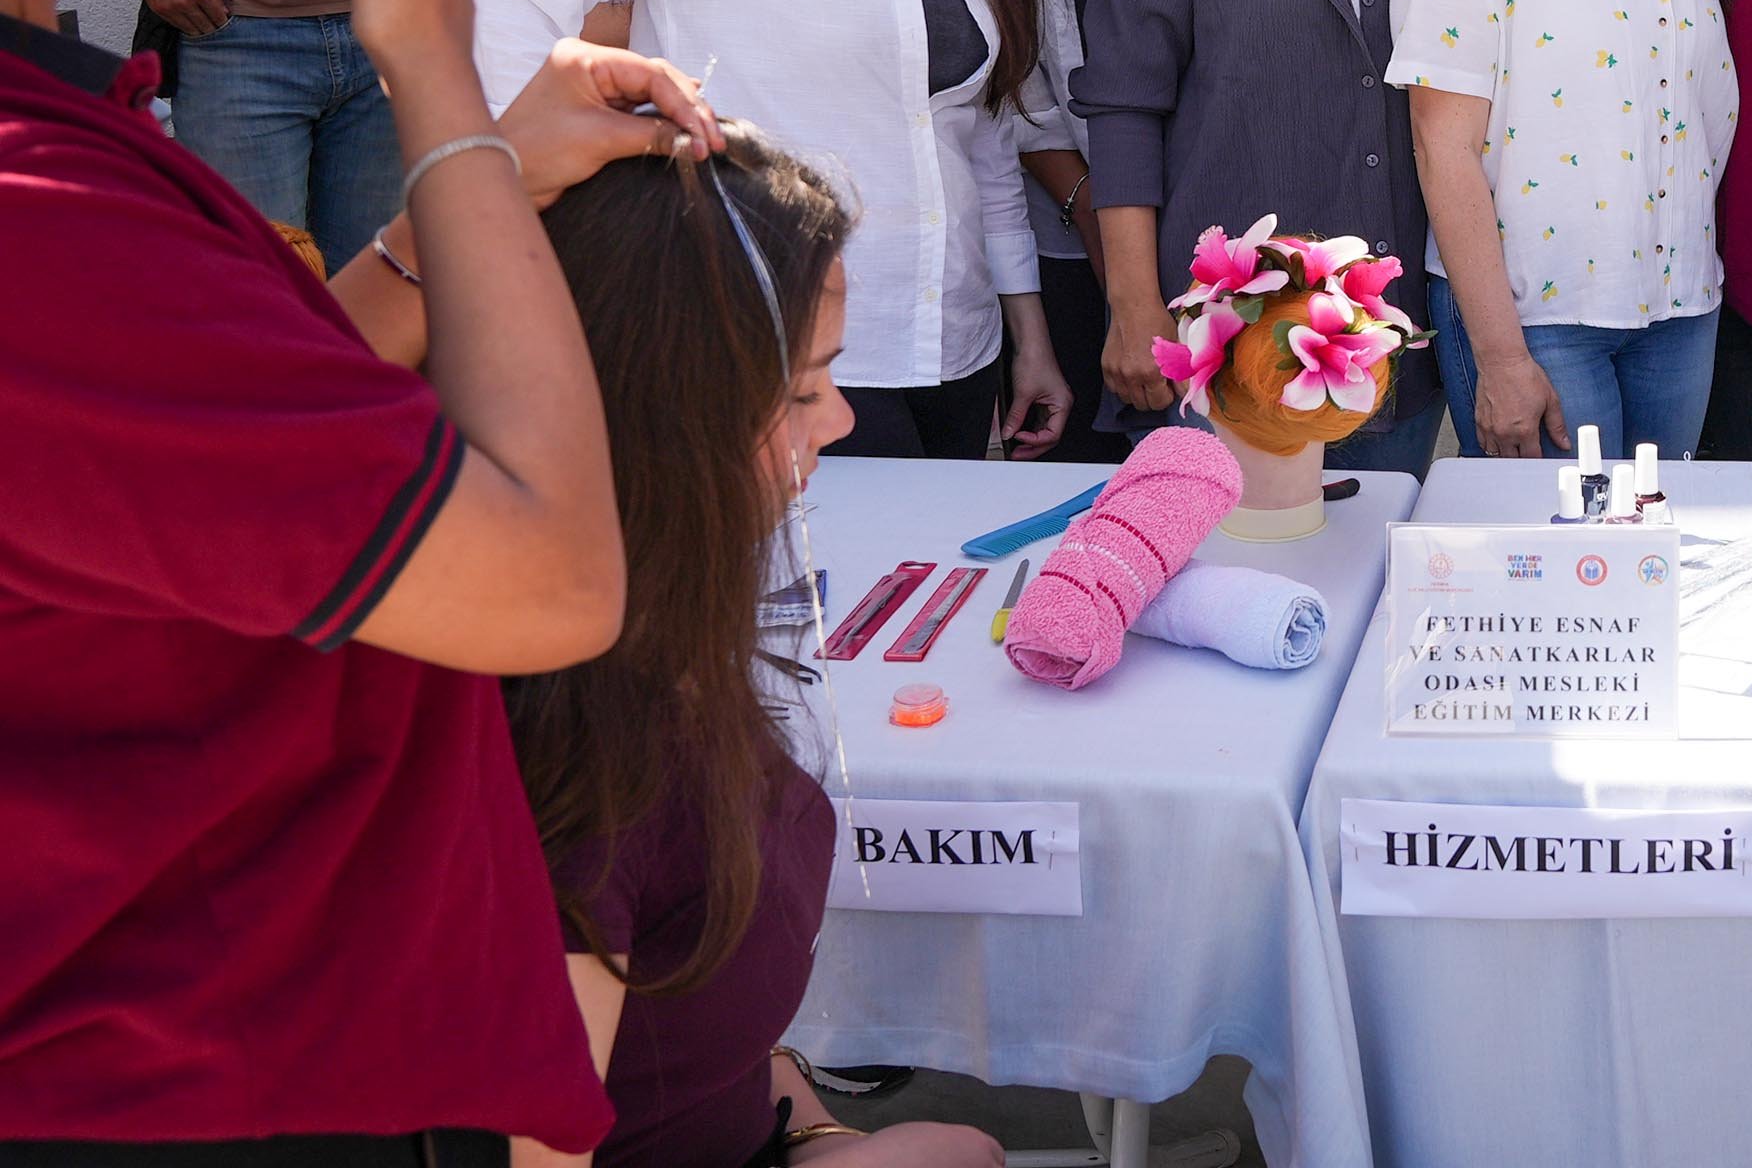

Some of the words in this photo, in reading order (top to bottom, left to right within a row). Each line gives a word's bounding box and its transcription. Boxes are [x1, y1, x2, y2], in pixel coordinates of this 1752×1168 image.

[1427, 613, 1543, 633] FETHİYE
[1556, 616, 1641, 633] ESNAF
[1409, 645, 1442, 662] VE
[1454, 645, 1656, 663] SANATKARLAR
[1424, 674, 1505, 691] ODASI
[1519, 672, 1640, 692] MESLEKİ
[1414, 700, 1512, 721] EĞİTİM
[1526, 702, 1650, 721] MERKEZİ
[853, 826, 1039, 865] BAKIM
[1383, 823, 1738, 875] HİZMETLERİ
